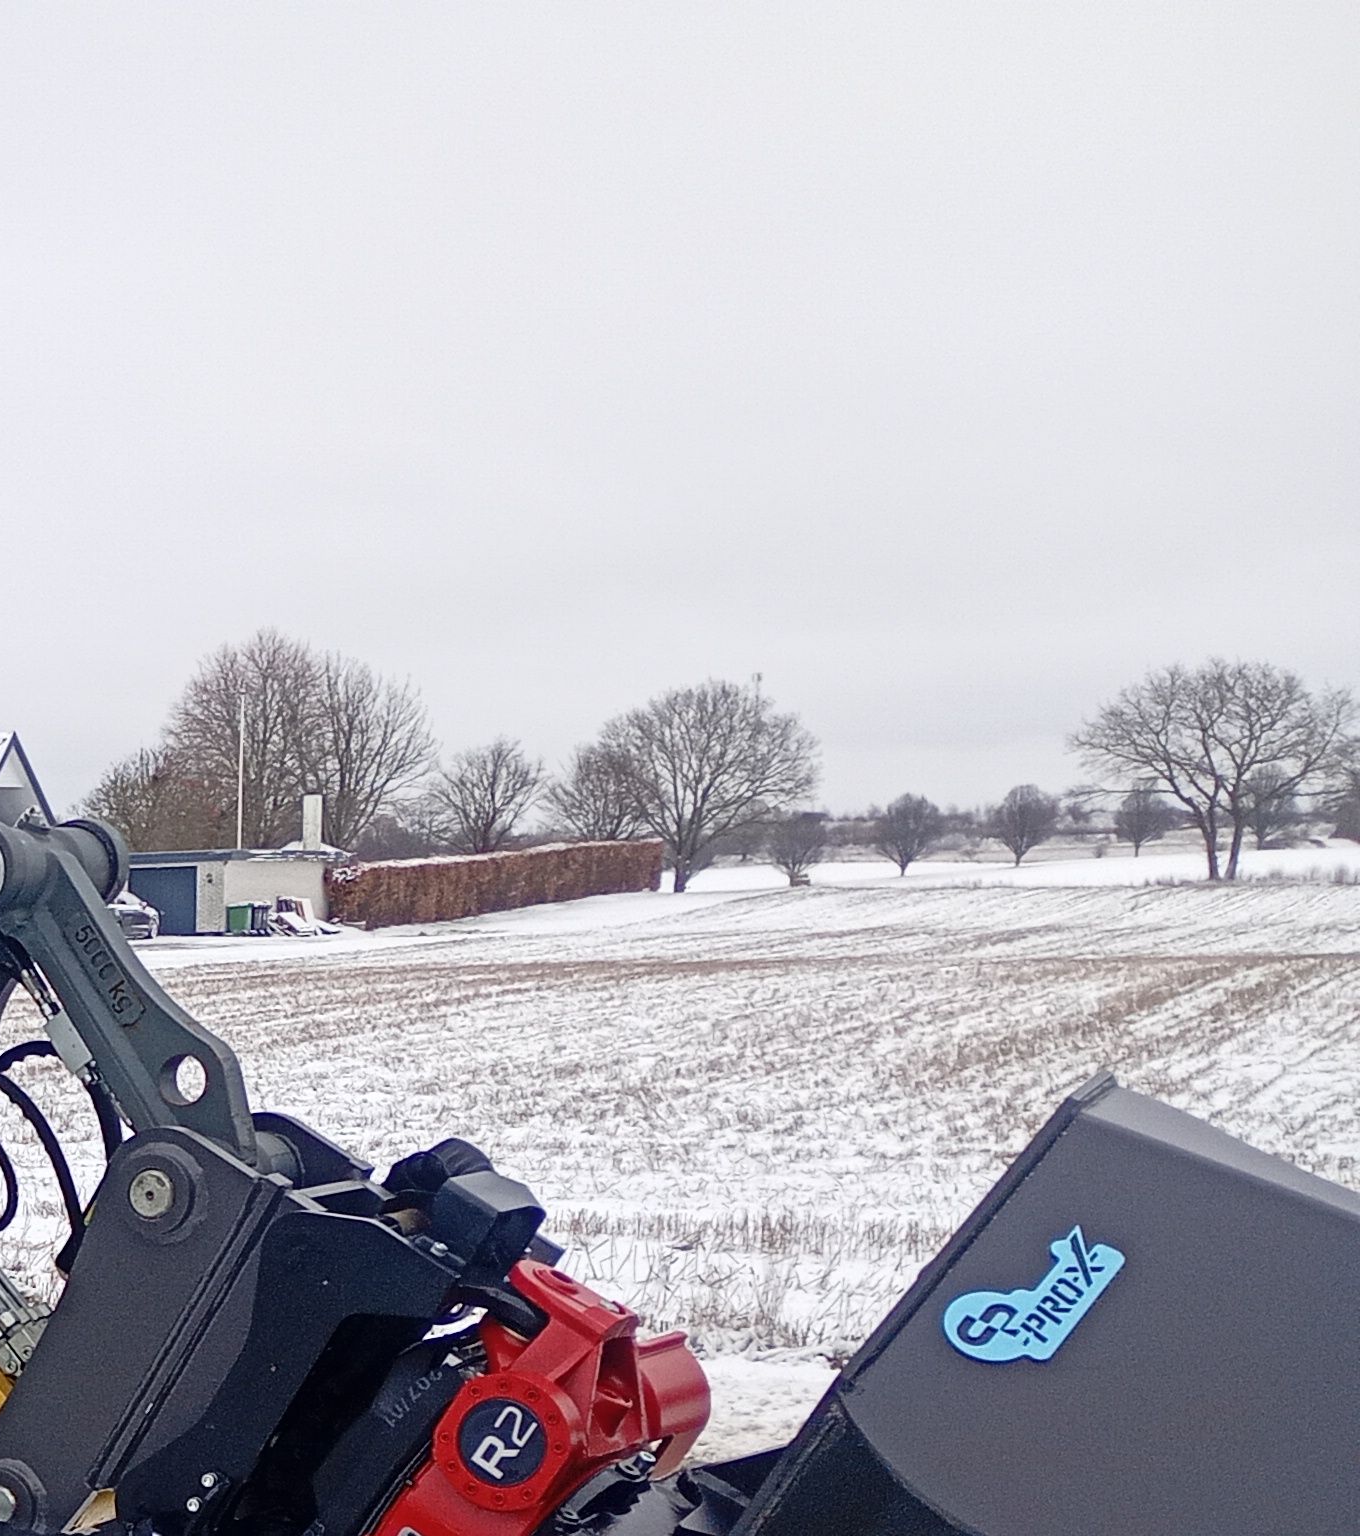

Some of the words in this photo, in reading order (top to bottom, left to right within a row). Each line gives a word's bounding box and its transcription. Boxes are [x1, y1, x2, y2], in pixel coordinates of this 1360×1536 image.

[75, 925, 116, 981] 5000
[108, 979, 131, 1014] kg
[470, 1405, 538, 1480] R2
